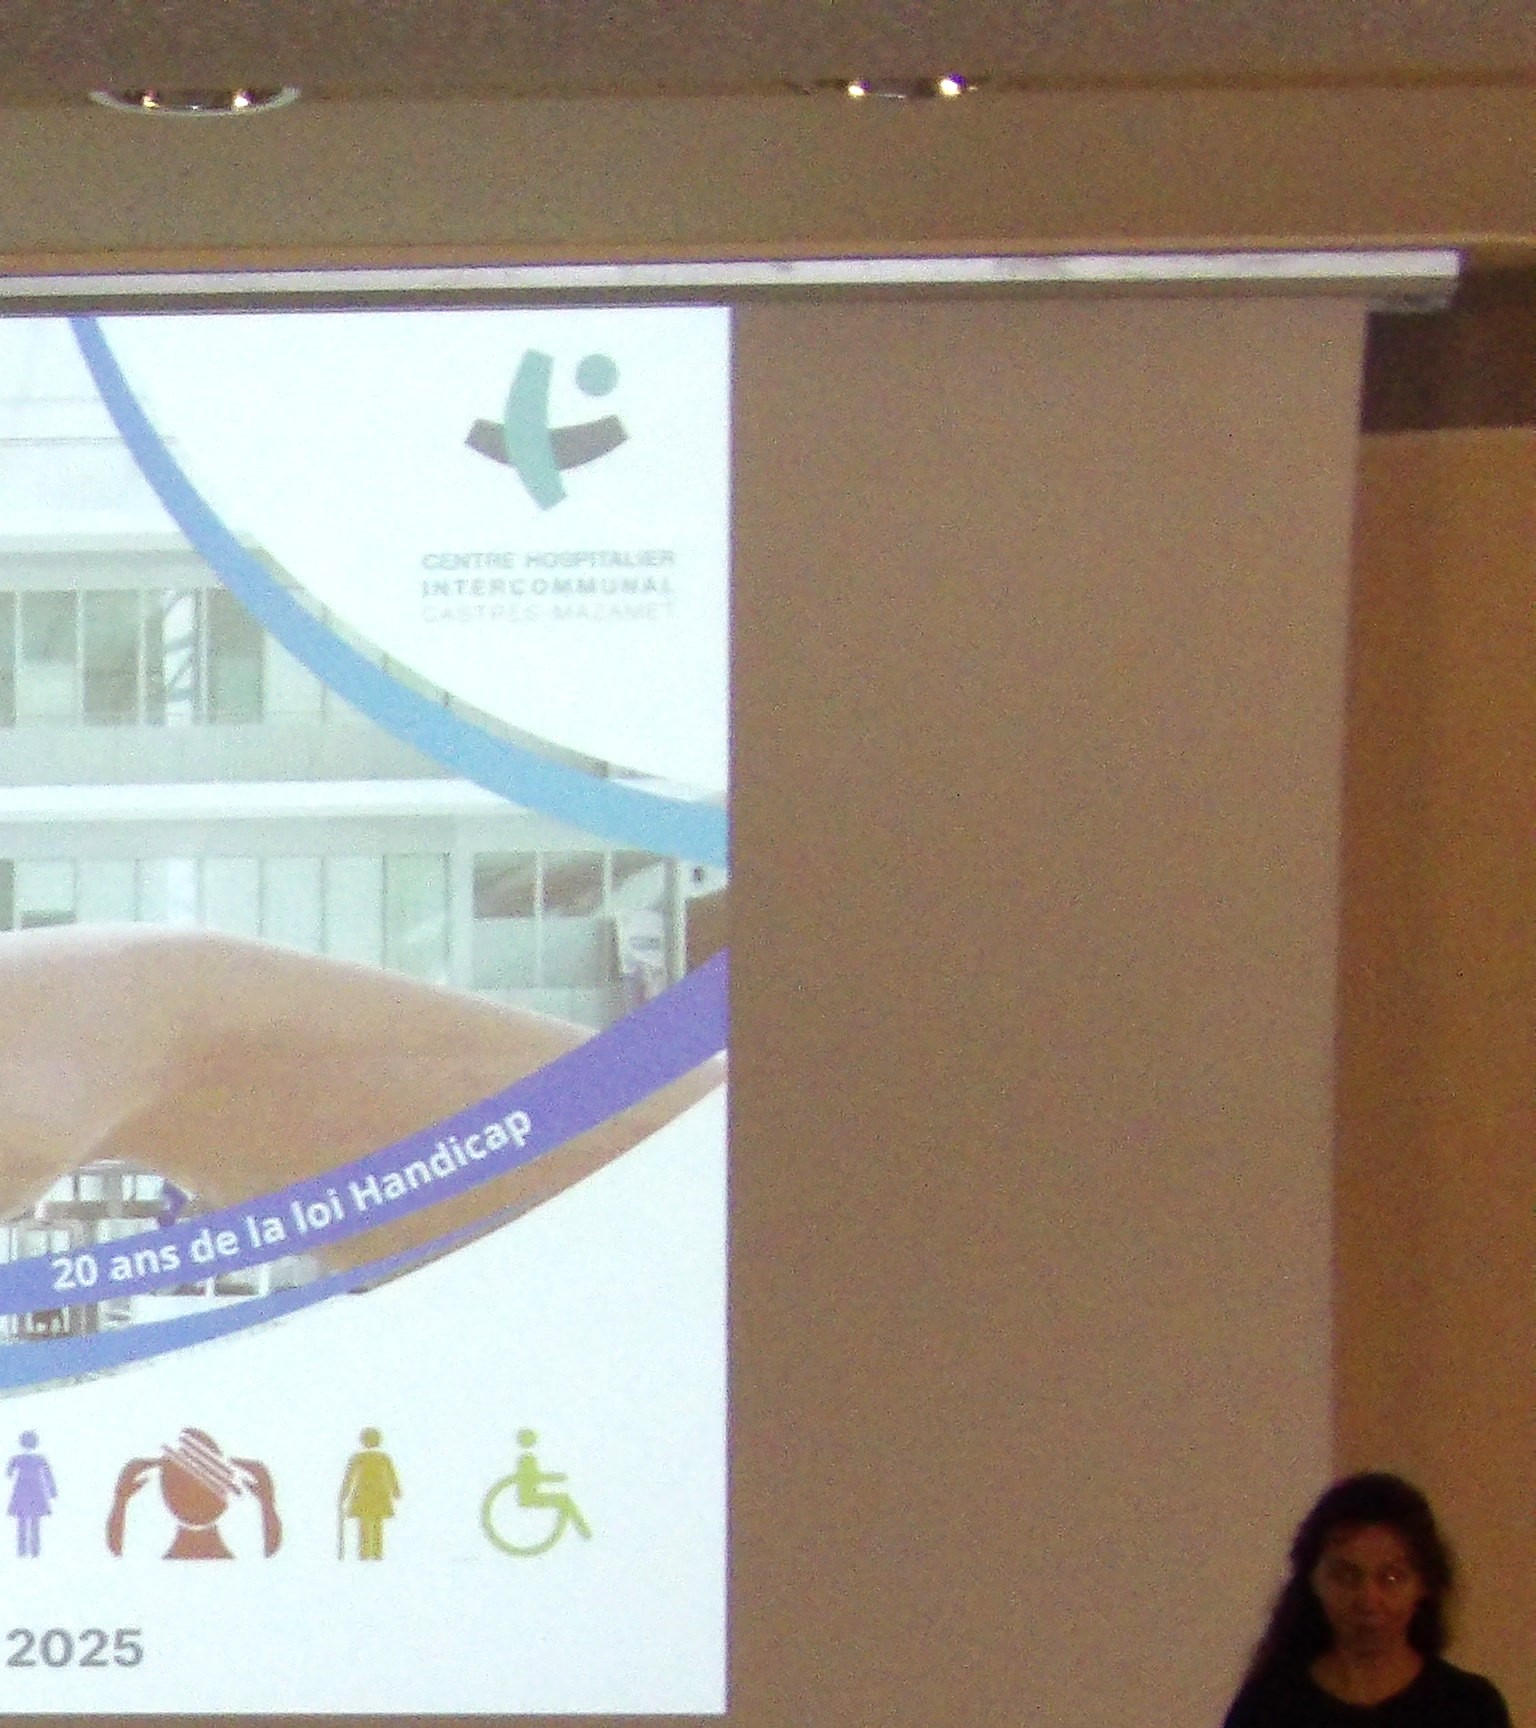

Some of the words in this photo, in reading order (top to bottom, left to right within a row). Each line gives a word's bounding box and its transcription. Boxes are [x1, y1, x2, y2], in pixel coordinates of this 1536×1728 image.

[422, 551, 514, 570] CENTRE
[526, 549, 676, 569] HOSPITALIER
[422, 577, 674, 597] INTERCOMMUNAL
[51, 1257, 99, 1292] 20
[110, 1244, 181, 1282] ans
[188, 1220, 240, 1264] de
[246, 1209, 286, 1248] la
[292, 1182, 346, 1232] loi
[349, 1107, 535, 1213] Handicap
[3, 1628, 145, 1668] 2025
